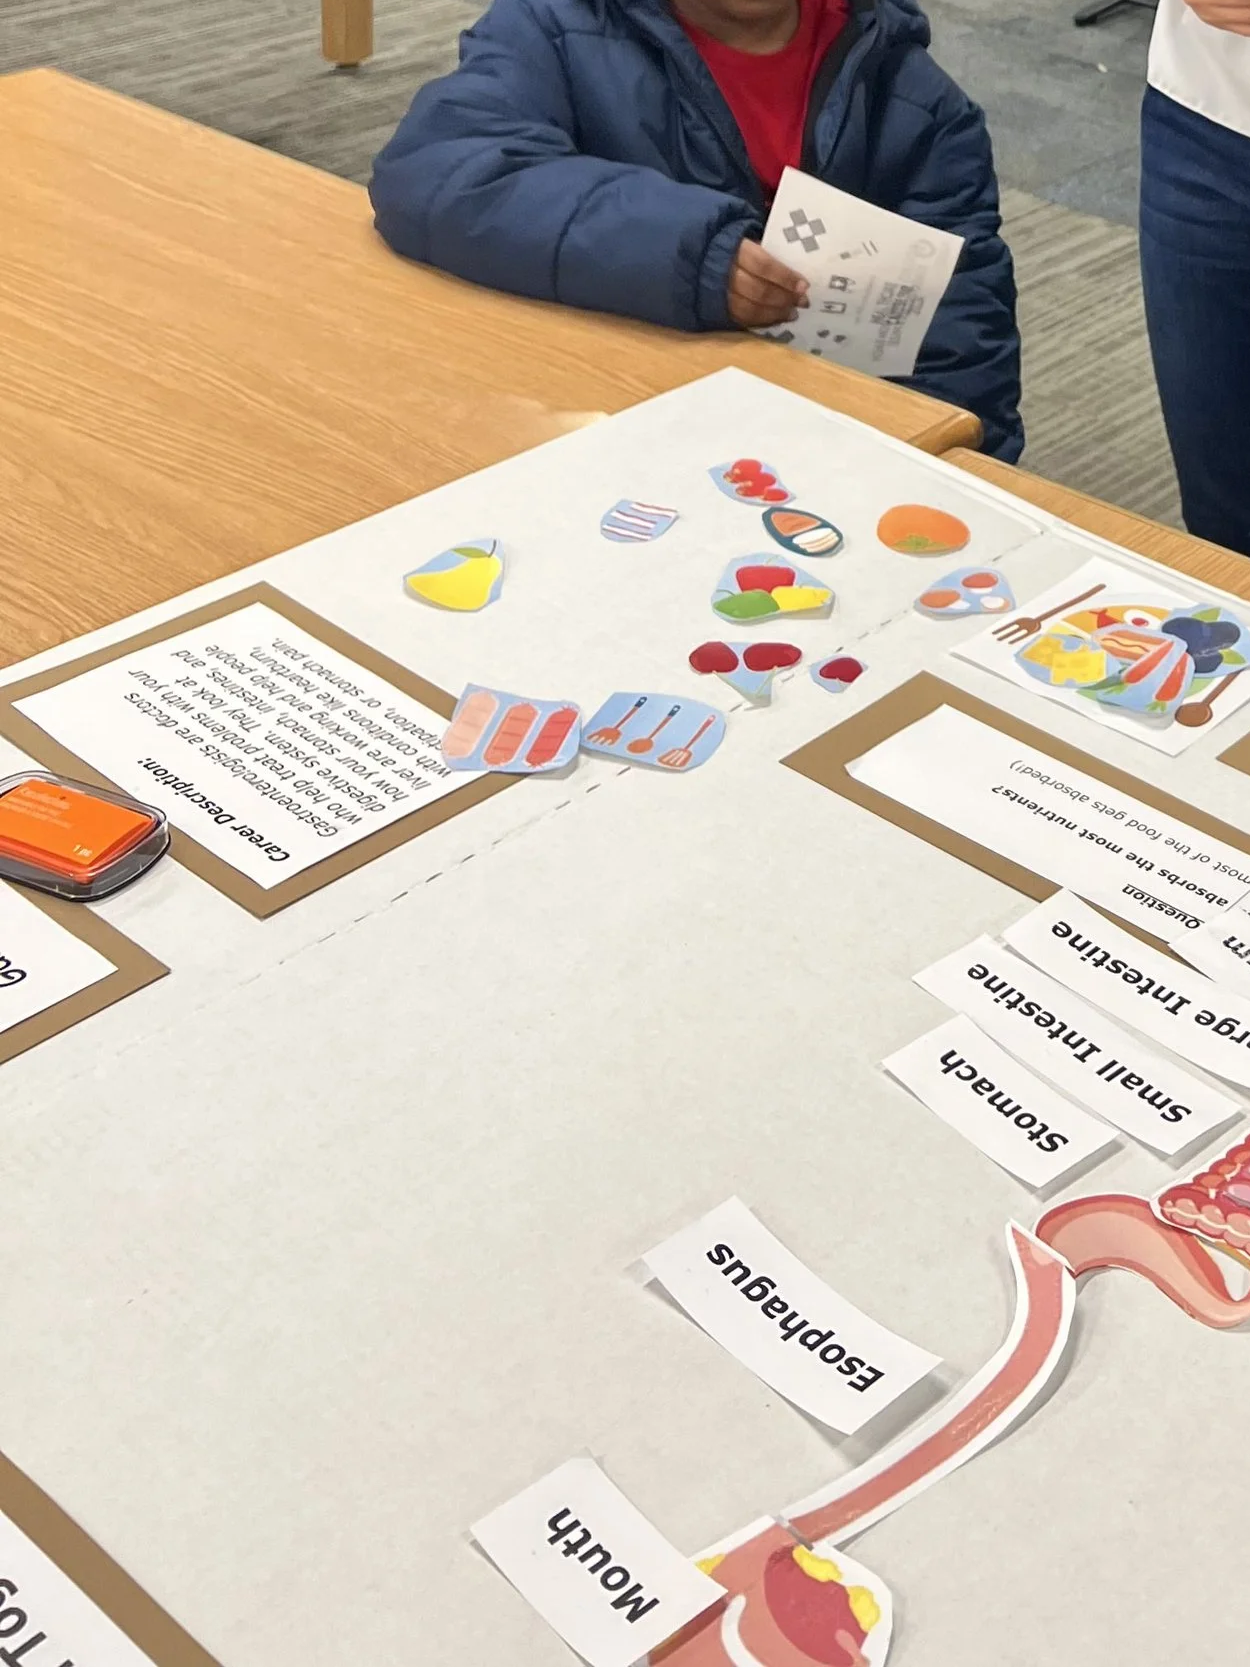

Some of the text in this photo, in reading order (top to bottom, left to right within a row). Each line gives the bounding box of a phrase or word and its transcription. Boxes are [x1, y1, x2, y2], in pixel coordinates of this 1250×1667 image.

[270, 637, 311, 662] pain.
[301, 659, 366, 698] stomach
[169, 649, 410, 803] how your stomach, intestines, and
[204, 644, 432, 792] liver are working and help people
[248, 646, 454, 779] with conditions like heartburn,
[358, 697, 383, 709] or
[123, 692, 339, 838] Gastroenterologists are doctors
[127, 669, 363, 826] who help treat problems with your
[173, 675, 387, 813] digestive system. They look at
[136, 757, 237, 826] Description:
[1008, 759, 1091, 804] absorbed!)
[990, 784, 1079, 832] nutrients?
[1090, 800, 1129, 821] gets
[1123, 818, 1164, 842] food
[229, 824, 291, 863] Career
[1077, 828, 1124, 855] most
[1124, 851, 1156, 873] the
[1163, 836, 1192, 856] the
[1188, 852, 1212, 864] of
[1121, 883, 1206, 930] Question
[1156, 868, 1230, 908] absorbs
[1051, 920, 1191, 1016] Intestine
[967, 963, 1192, 1123] Small Intestine
[940, 1049, 1069, 1153] Stomach
[706, 1243, 885, 1392] Esophagus
[547, 1507, 660, 1624] Mouth
